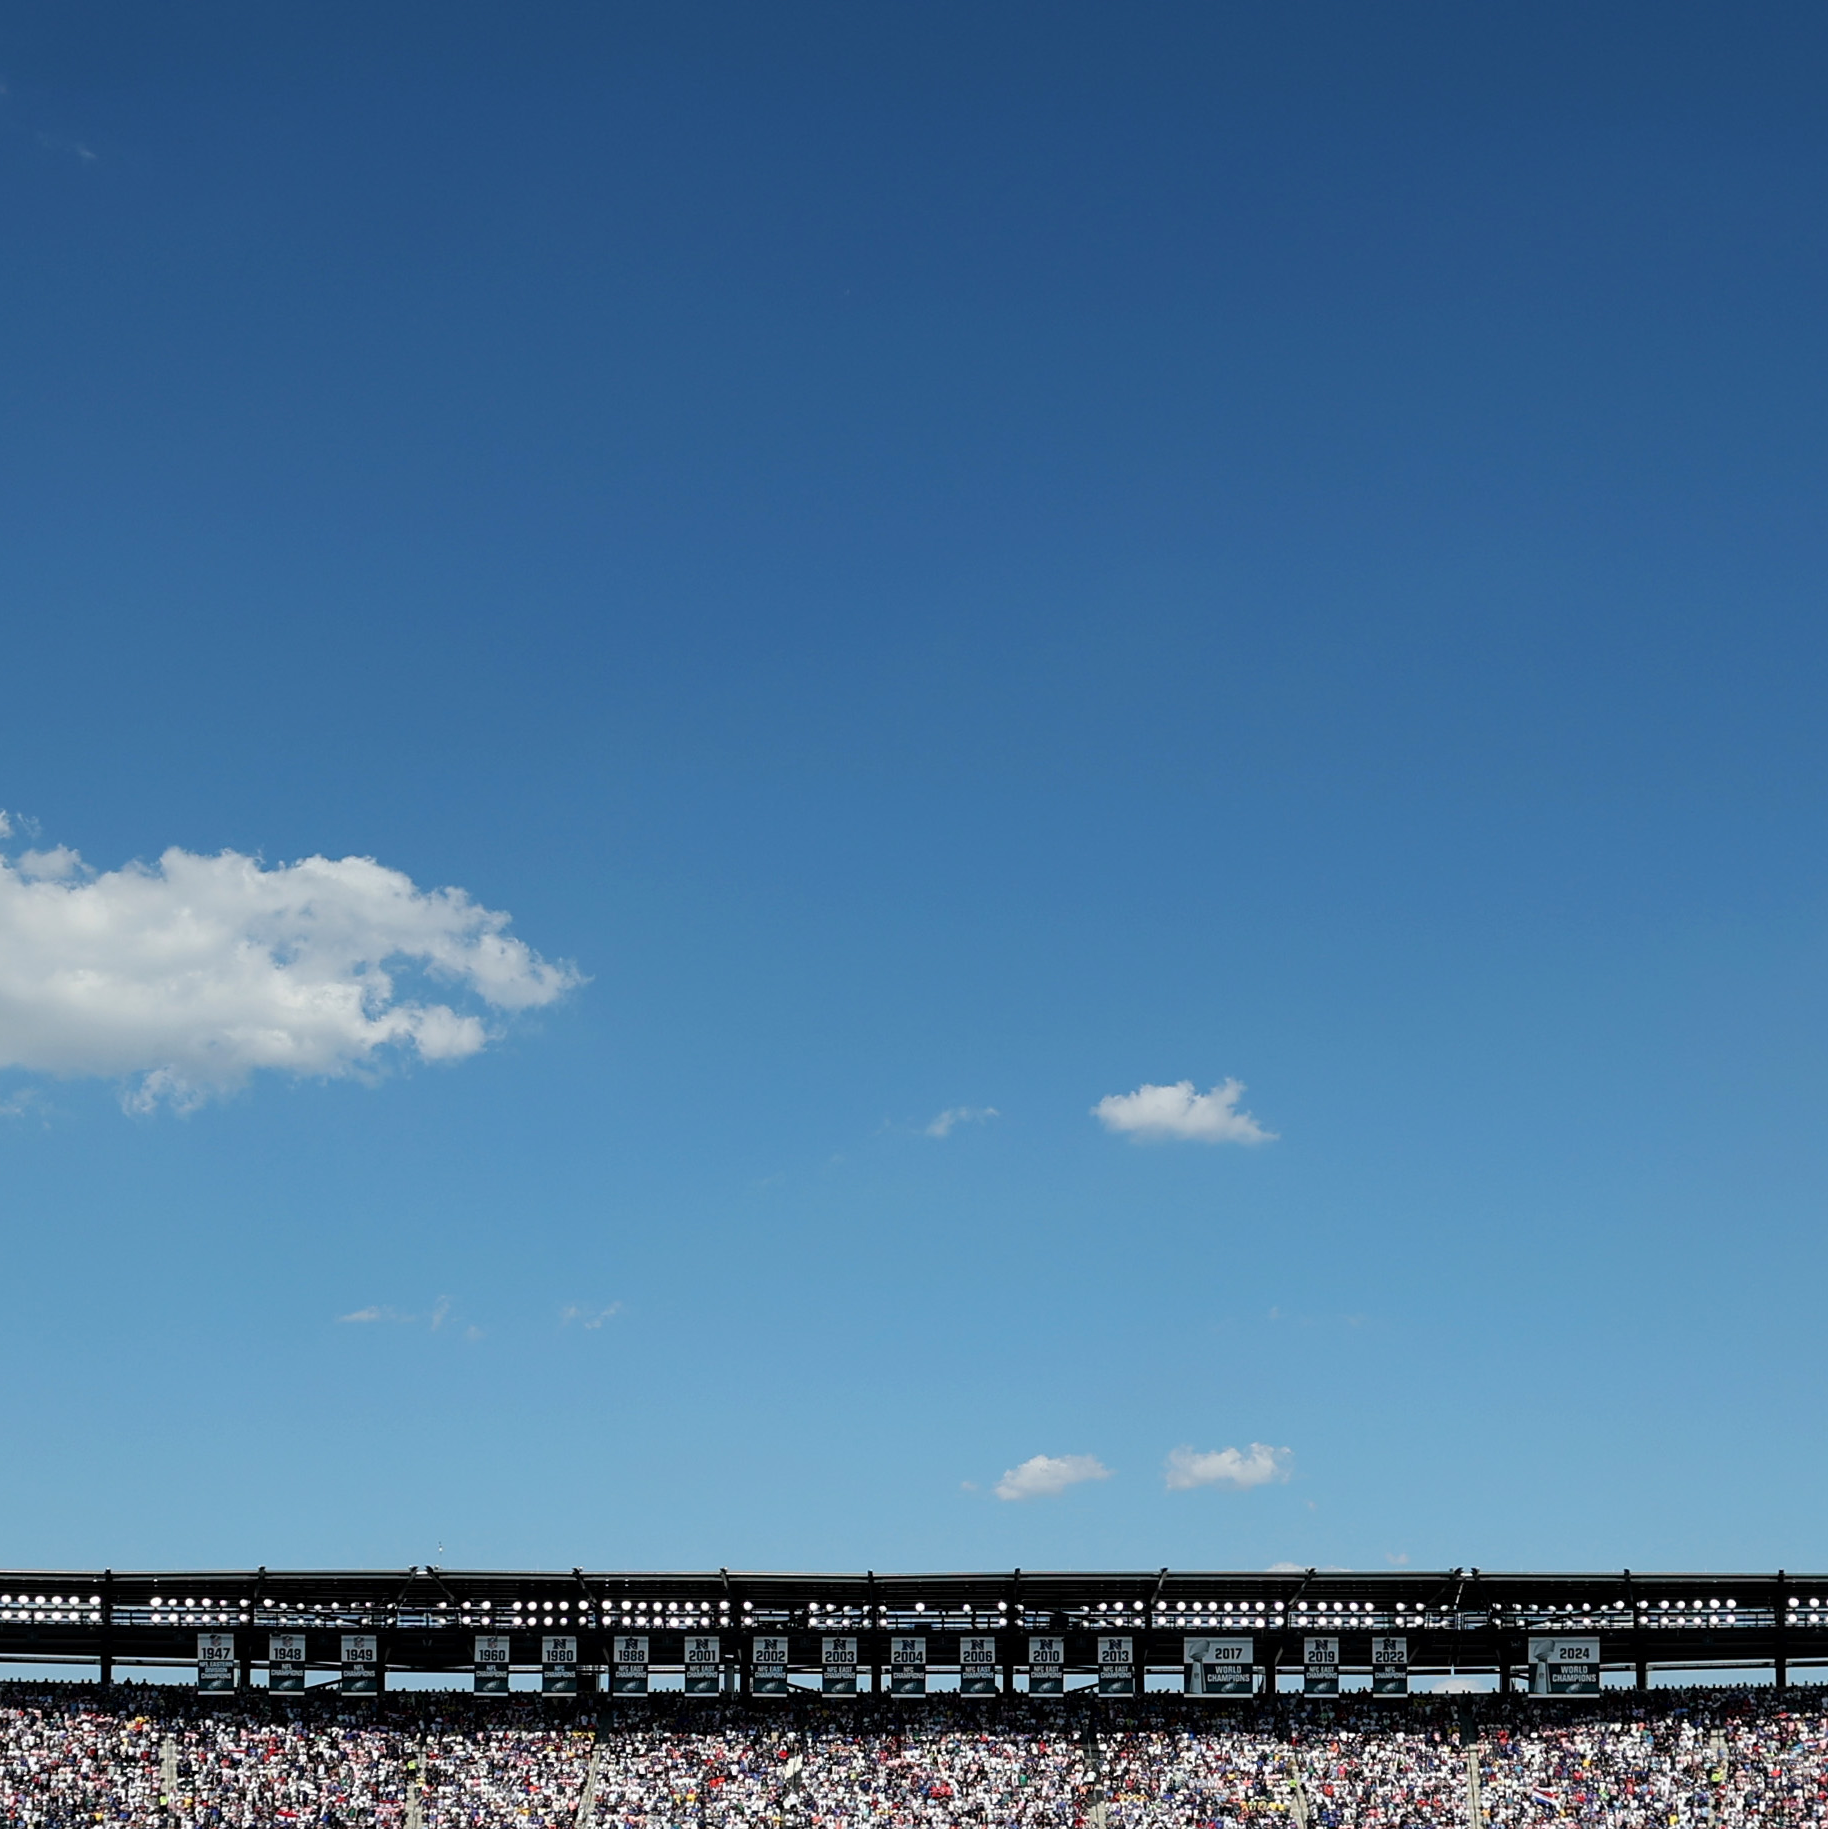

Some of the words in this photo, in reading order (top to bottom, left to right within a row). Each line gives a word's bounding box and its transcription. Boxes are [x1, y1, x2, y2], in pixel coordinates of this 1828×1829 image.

[201, 1647, 231, 1660] 1947
[273, 1648, 302, 1660] 1948
[345, 1649, 374, 1661] 1949
[479, 1649, 506, 1661] 1960
[546, 1649, 574, 1661] 1980
[617, 1649, 645, 1662] 1988
[688, 1649, 716, 1662] 2001
[755, 1650, 785, 1663] 2002
[825, 1650, 854, 1663] 2003
[893, 1650, 924, 1663] 2004
[963, 1650, 993, 1663] 2006
[1033, 1650, 1060, 1662] 2010
[1102, 1650, 1129, 1662] 2013
[1215, 1647, 1243, 1660] 2017
[1308, 1651, 1335, 1663] 2019
[1375, 1651, 1405, 1662] 2022
[1559, 1647, 1590, 1659] 2024
[200, 1672, 232, 1680] CHAMPIONS
[271, 1669, 304, 1677] CHAMPIONS
[1207, 1673, 1250, 1683] CHAMPIONS
[1552, 1674, 1597, 1682] CHAMPIONS
